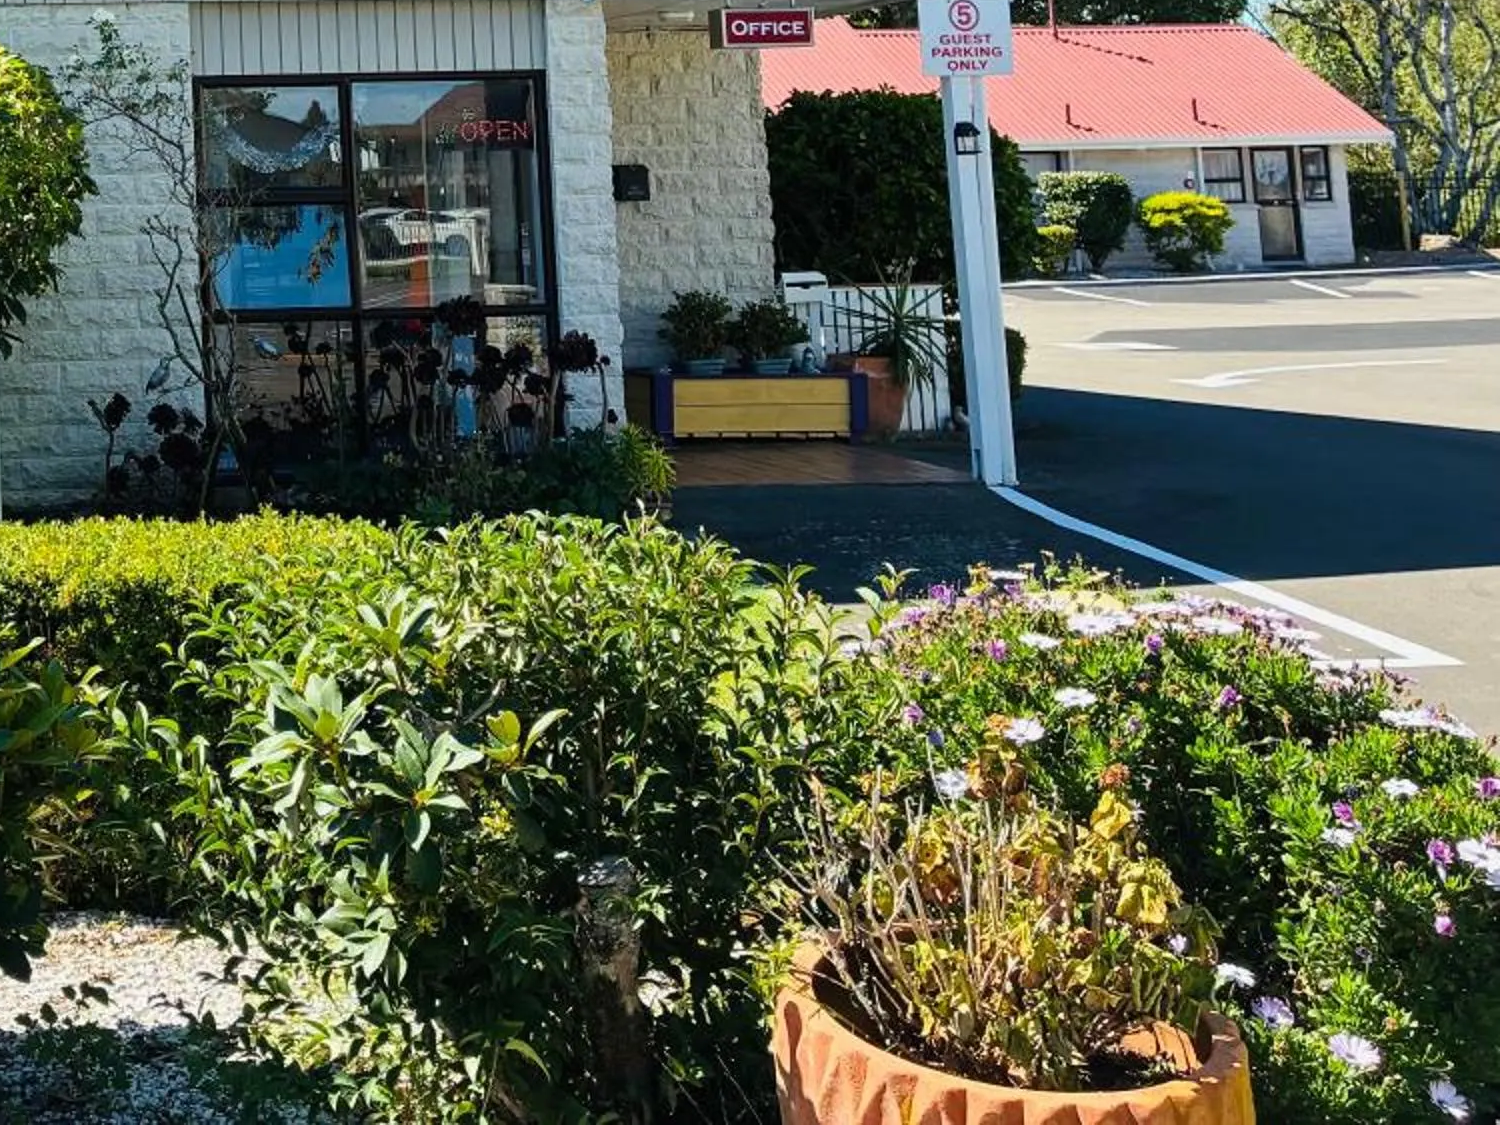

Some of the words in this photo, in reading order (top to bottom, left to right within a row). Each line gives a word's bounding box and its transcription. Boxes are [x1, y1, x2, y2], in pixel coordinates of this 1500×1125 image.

[956, 4, 973, 26] 5
[731, 20, 805, 36] OFFICE
[939, 34, 991, 45] GUEST
[931, 46, 1003, 57] PARKING
[947, 60, 988, 71] ONLY
[461, 120, 529, 143] OPEN
